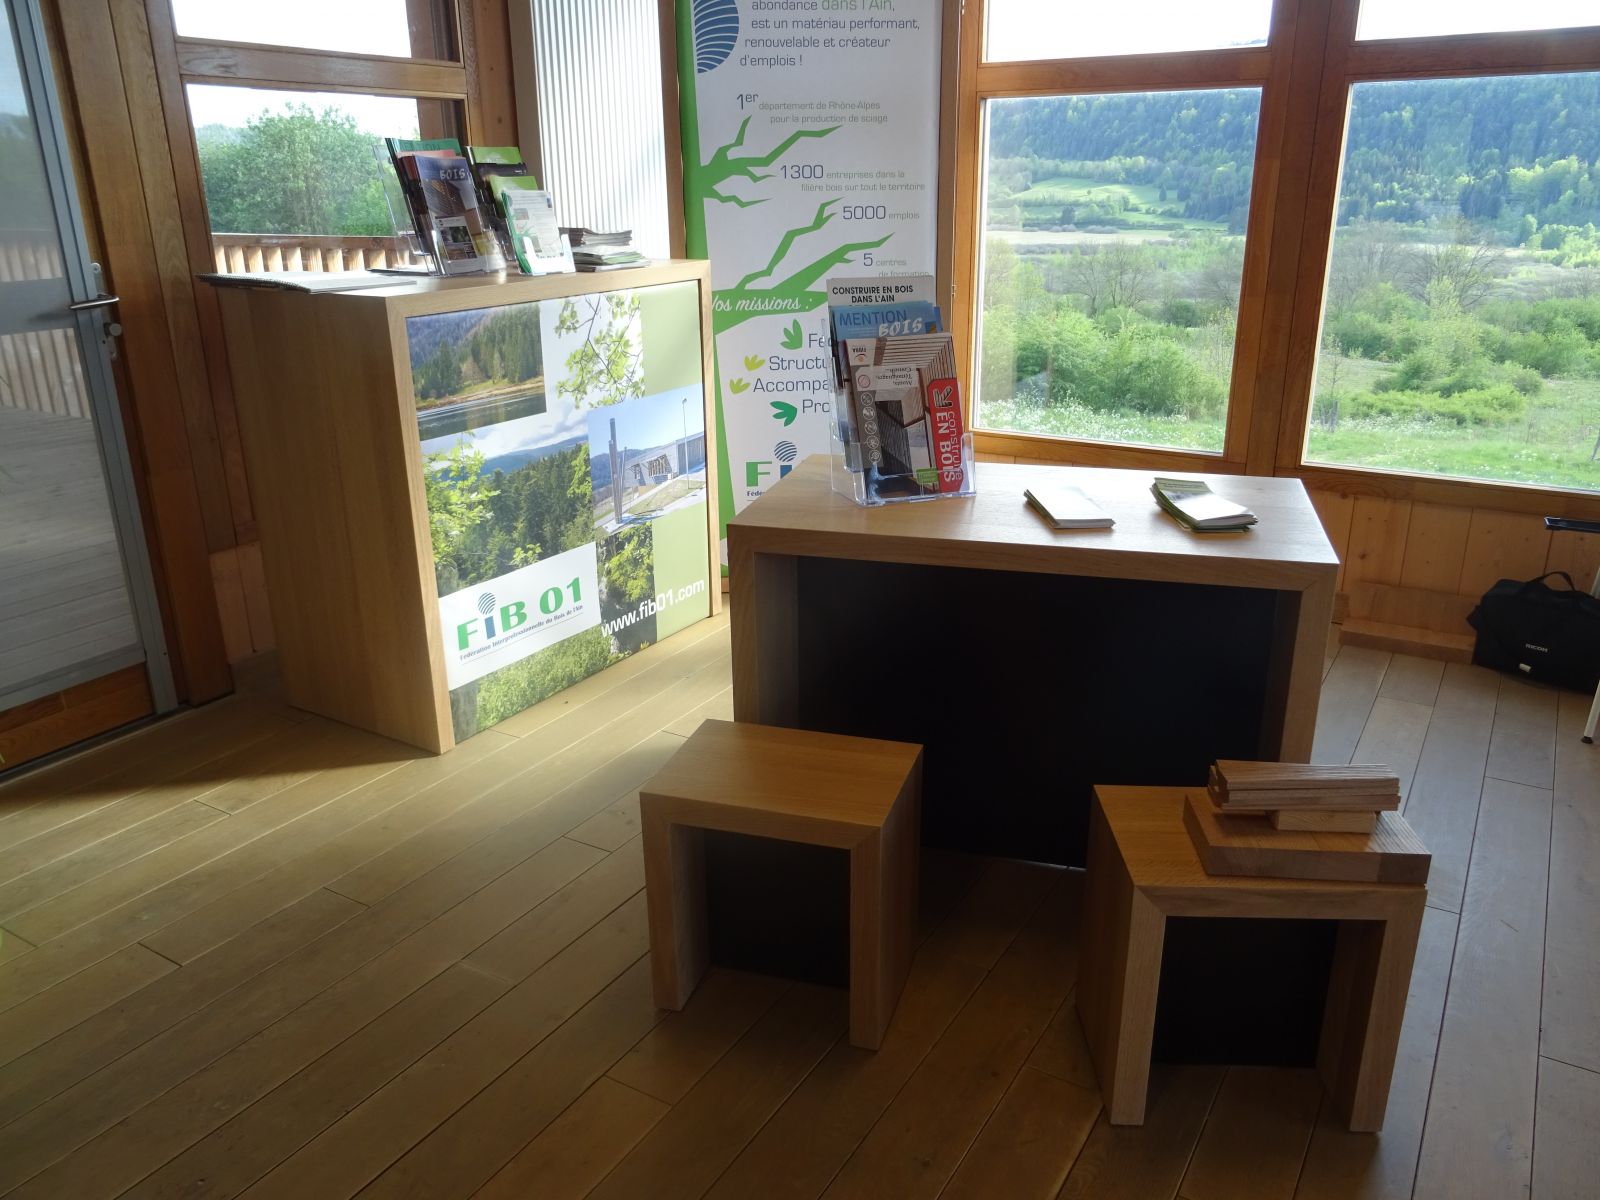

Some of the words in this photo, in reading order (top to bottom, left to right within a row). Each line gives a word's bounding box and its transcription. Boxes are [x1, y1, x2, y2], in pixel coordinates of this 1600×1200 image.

[752, 0, 817, 11] abondance
[822, 0, 857, 11] dans
[862, 0, 895, 12] lAin,
[751, 19, 770, 29] est
[774, 21, 788, 29] un
[792, 18, 846, 29] matériau
[850, 17, 920, 31] performant,
[745, 36, 819, 48] renouvelable
[823, 37, 835, 48] et
[839, 37, 890, 48] créateur
[740, 54, 796, 68] d'emplois
[737, 93, 759, 110] 1er
[758, 101, 814, 111] département
[816, 101, 827, 110] de
[770, 115, 789, 124] pour
[792, 113, 800, 122] la
[801, 113, 845, 124] production
[848, 113, 859, 122] de
[861, 113, 888, 124] sciage
[780, 164, 824, 179] 1300
[826, 170, 874, 180] entreprises
[875, 170, 896, 178] dans
[898, 169, 905, 178] la
[801, 183, 823, 192] filière
[825, 183, 843, 191] bois
[860, 183, 877, 191] tout
[879, 182, 887, 191] le
[888, 182, 926, 191] territoire
[842, 205, 887, 220] 5000
[889, 211, 920, 221] emplois
[863, 253, 873, 267] 5
[832, 286, 880, 295] CONSTRUIRE
[882, 286, 893, 294] EN
[895, 285, 914, 294] BOIS
[735, 296, 801, 311] missions
[851, 295, 873, 303] DANS
[875, 294, 895, 302] L'AIN
[840, 309, 907, 326] MENTION
[936, 412, 950, 434] EN
[948, 411, 963, 480] construire
[939, 441, 956, 483] BOIS
[539, 576, 582, 615] 01
[601, 580, 705, 638] www.fib01.com
[1525, 643, 1549, 653] RICOH
